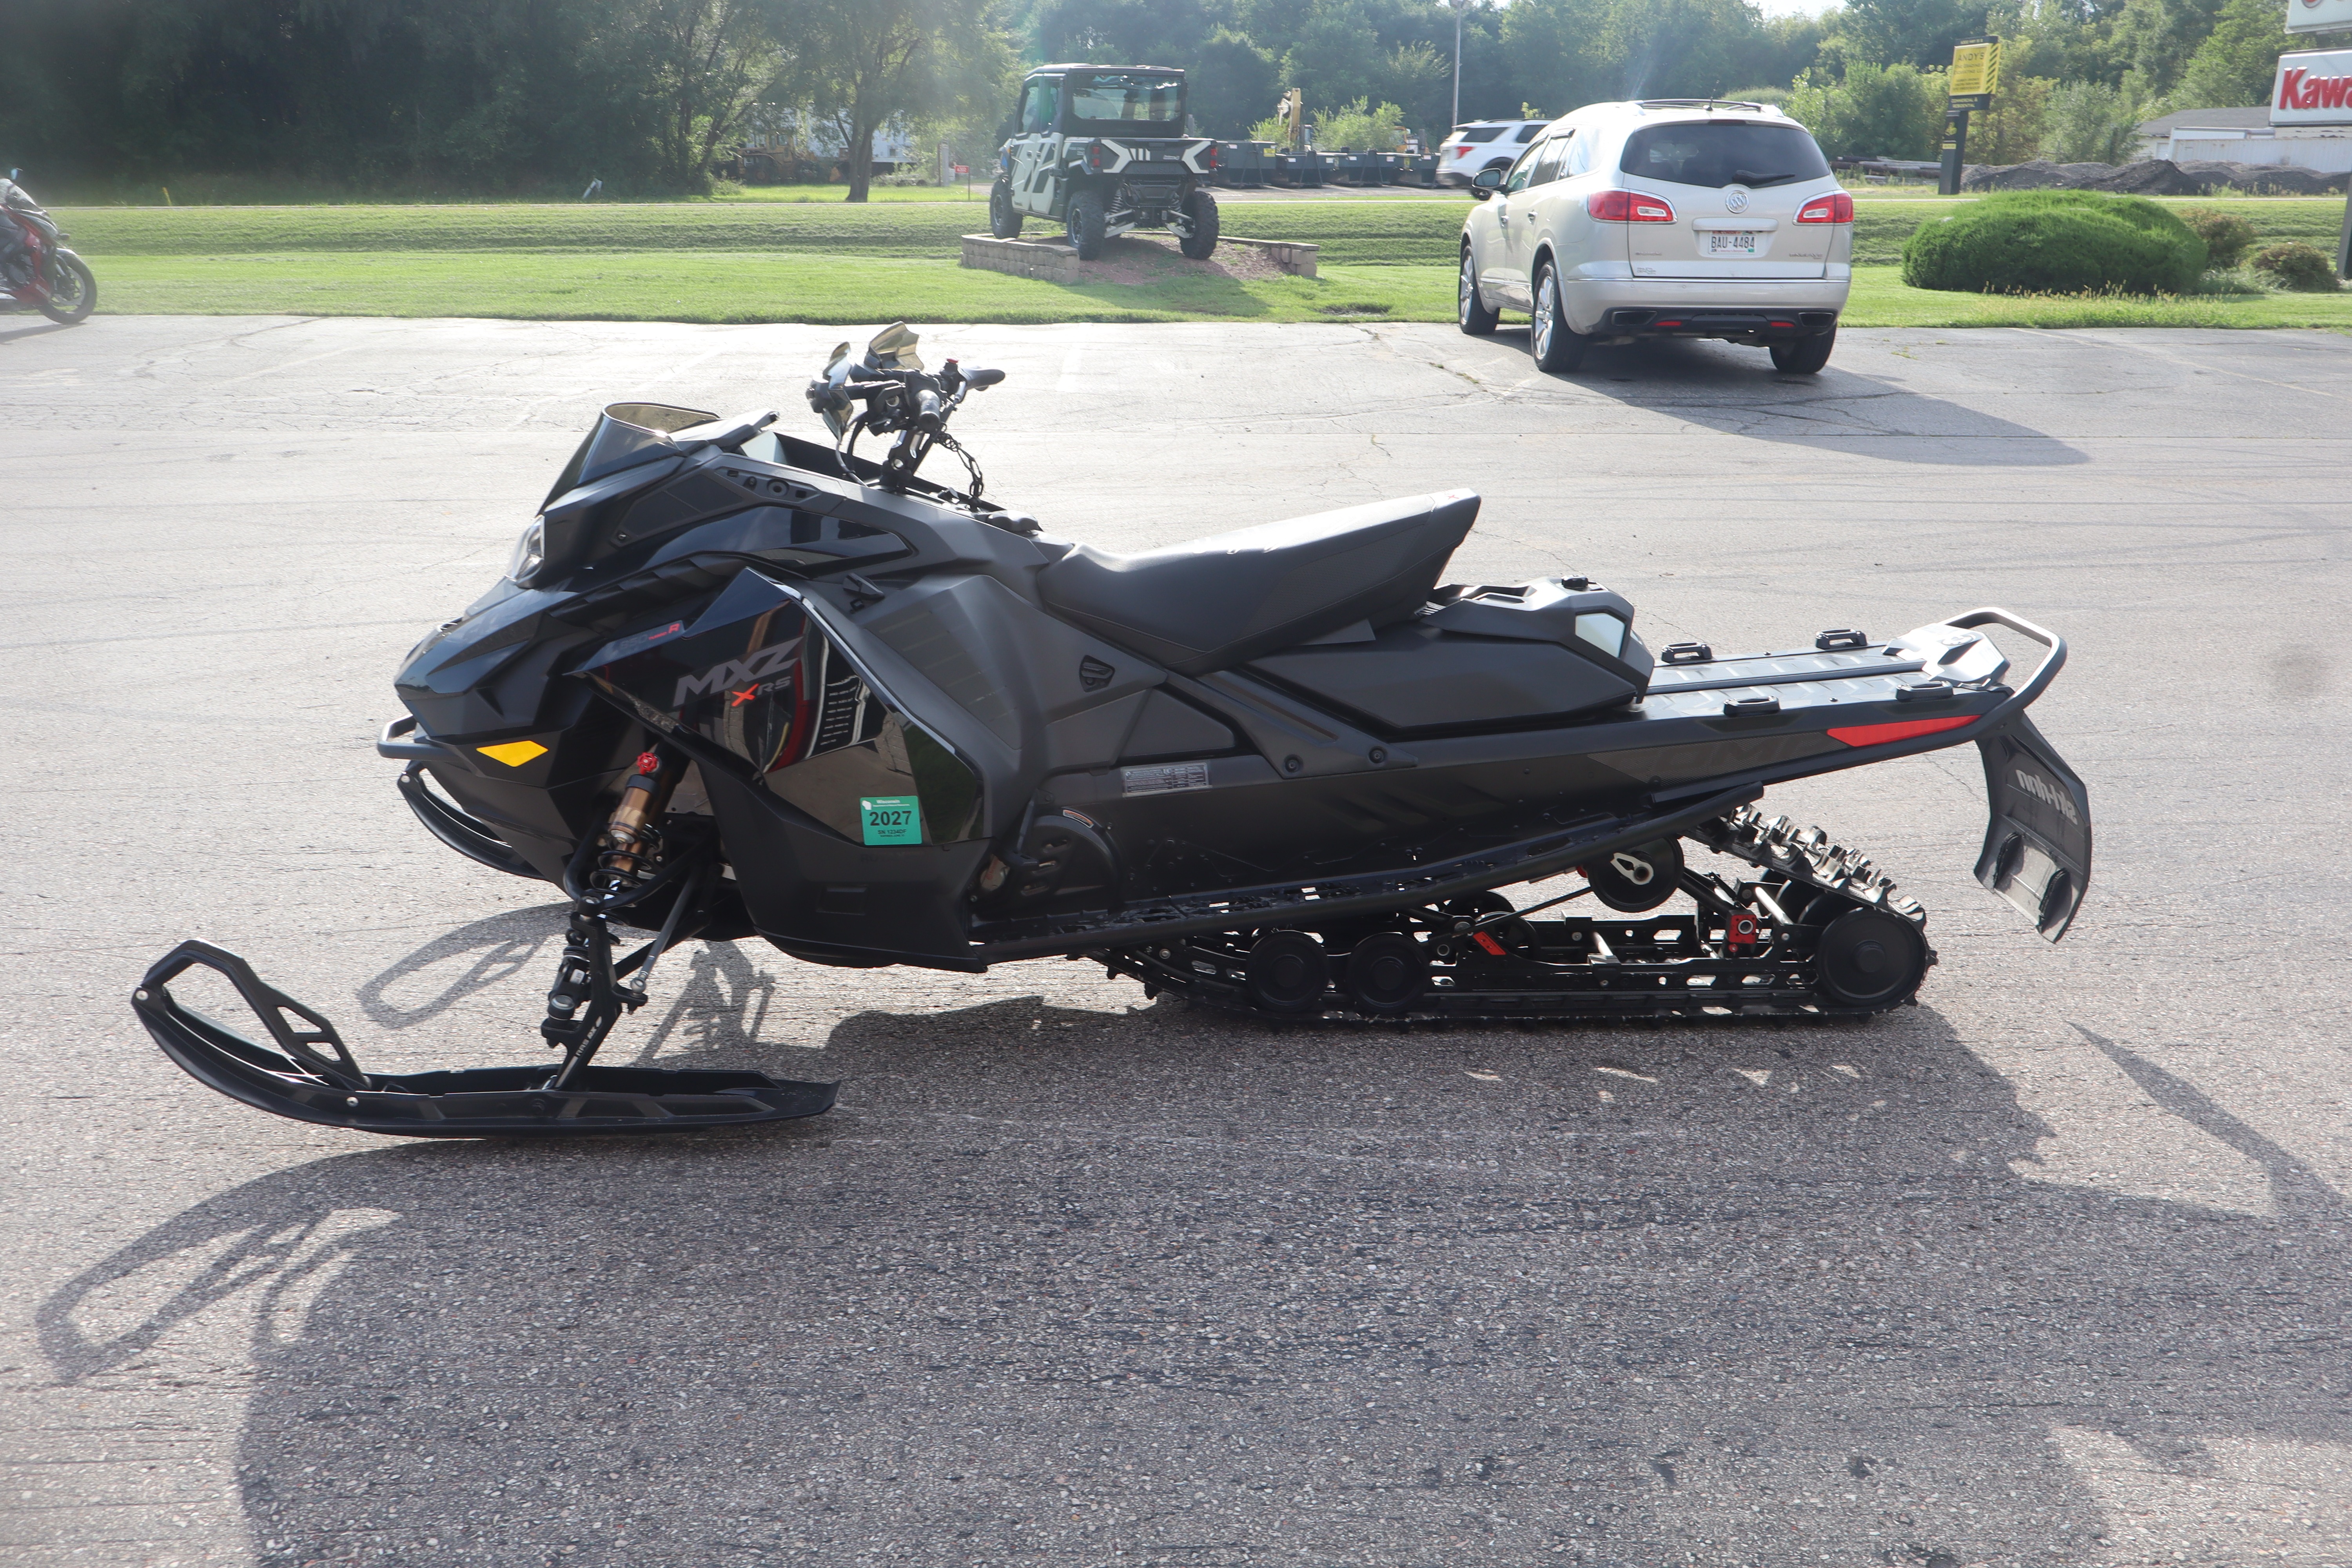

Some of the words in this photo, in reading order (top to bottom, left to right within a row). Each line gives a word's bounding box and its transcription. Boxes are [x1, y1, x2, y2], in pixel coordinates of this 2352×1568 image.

[1958, 52, 1985, 61] ANDY'S
[1711, 236, 1755, 248] BAU-4484
[668, 623, 681, 633] R
[673, 636, 804, 707] MXZ
[869, 811, 912, 826] 2027
